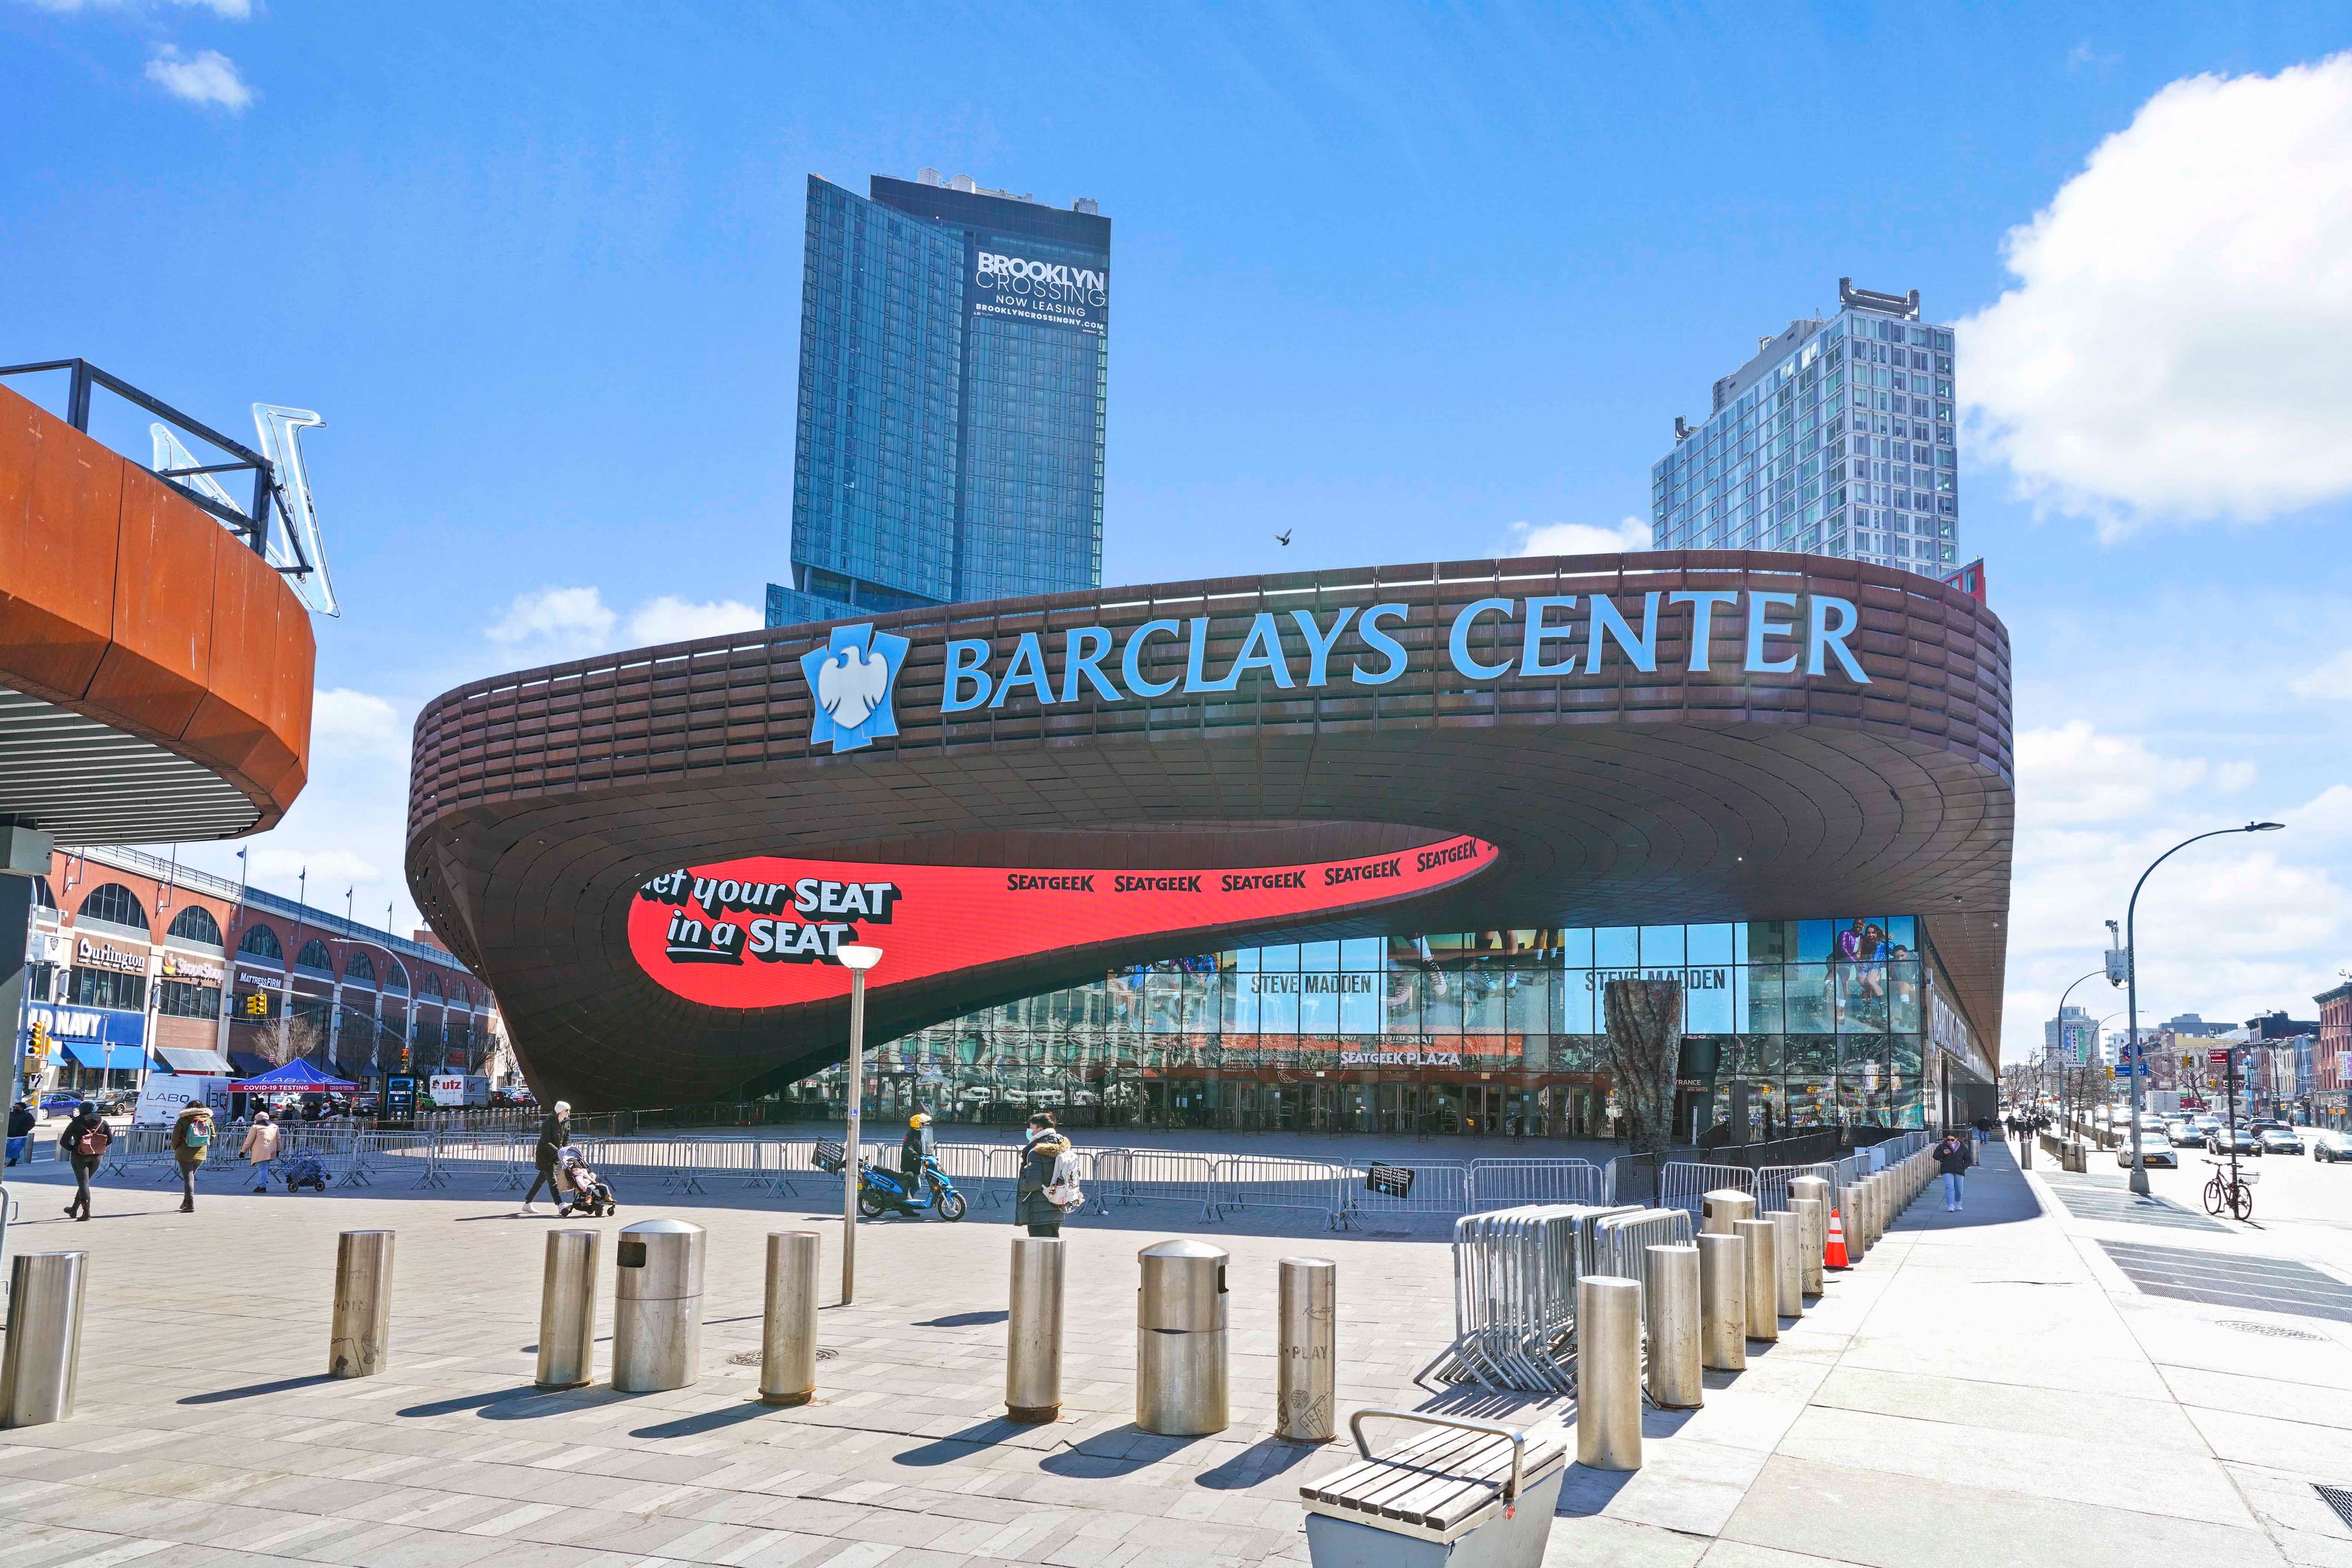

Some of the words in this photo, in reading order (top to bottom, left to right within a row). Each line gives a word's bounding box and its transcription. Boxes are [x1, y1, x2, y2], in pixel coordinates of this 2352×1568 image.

[978, 252, 1104, 291] BROOKLYN
[976, 271, 1105, 306] CROSSING
[975, 303, 1103, 330] BROOKLYNCROSSINGNY.COM
[996, 295, 1028, 307] NOW
[1032, 300, 1086, 317] LEASING
[940, 603, 1409, 713] BARCLAYS
[1448, 590, 1872, 684] CENTER
[1007, 874, 1095, 892] SEATGEEK
[1114, 875, 1201, 893] SEATGEEK
[1221, 870, 1307, 892] SEATGEEK
[1324, 857, 1401, 887] SEATGEEK
[1416, 838, 1478, 873] SEATGEEK
[693, 877, 785, 910] your
[794, 878, 893, 915] SEAT
[667, 909, 701, 944] in
[711, 923, 736, 946] a
[748, 918, 849, 956] SEAT
[79, 937, 145, 970] Burlington
[1250, 975, 1299, 994] STEVE
[1305, 974, 1371, 994] MADDEN
[54, 1011, 101, 1037] NAVY
[1340, 1051, 1404, 1066] SEATGEEK
[1407, 1053, 1461, 1066] PLAZA
[146, 1092, 190, 1104] LABQ
[442, 1080, 461, 1090] utz
[1292, 1345, 1328, 1360] PLAY
